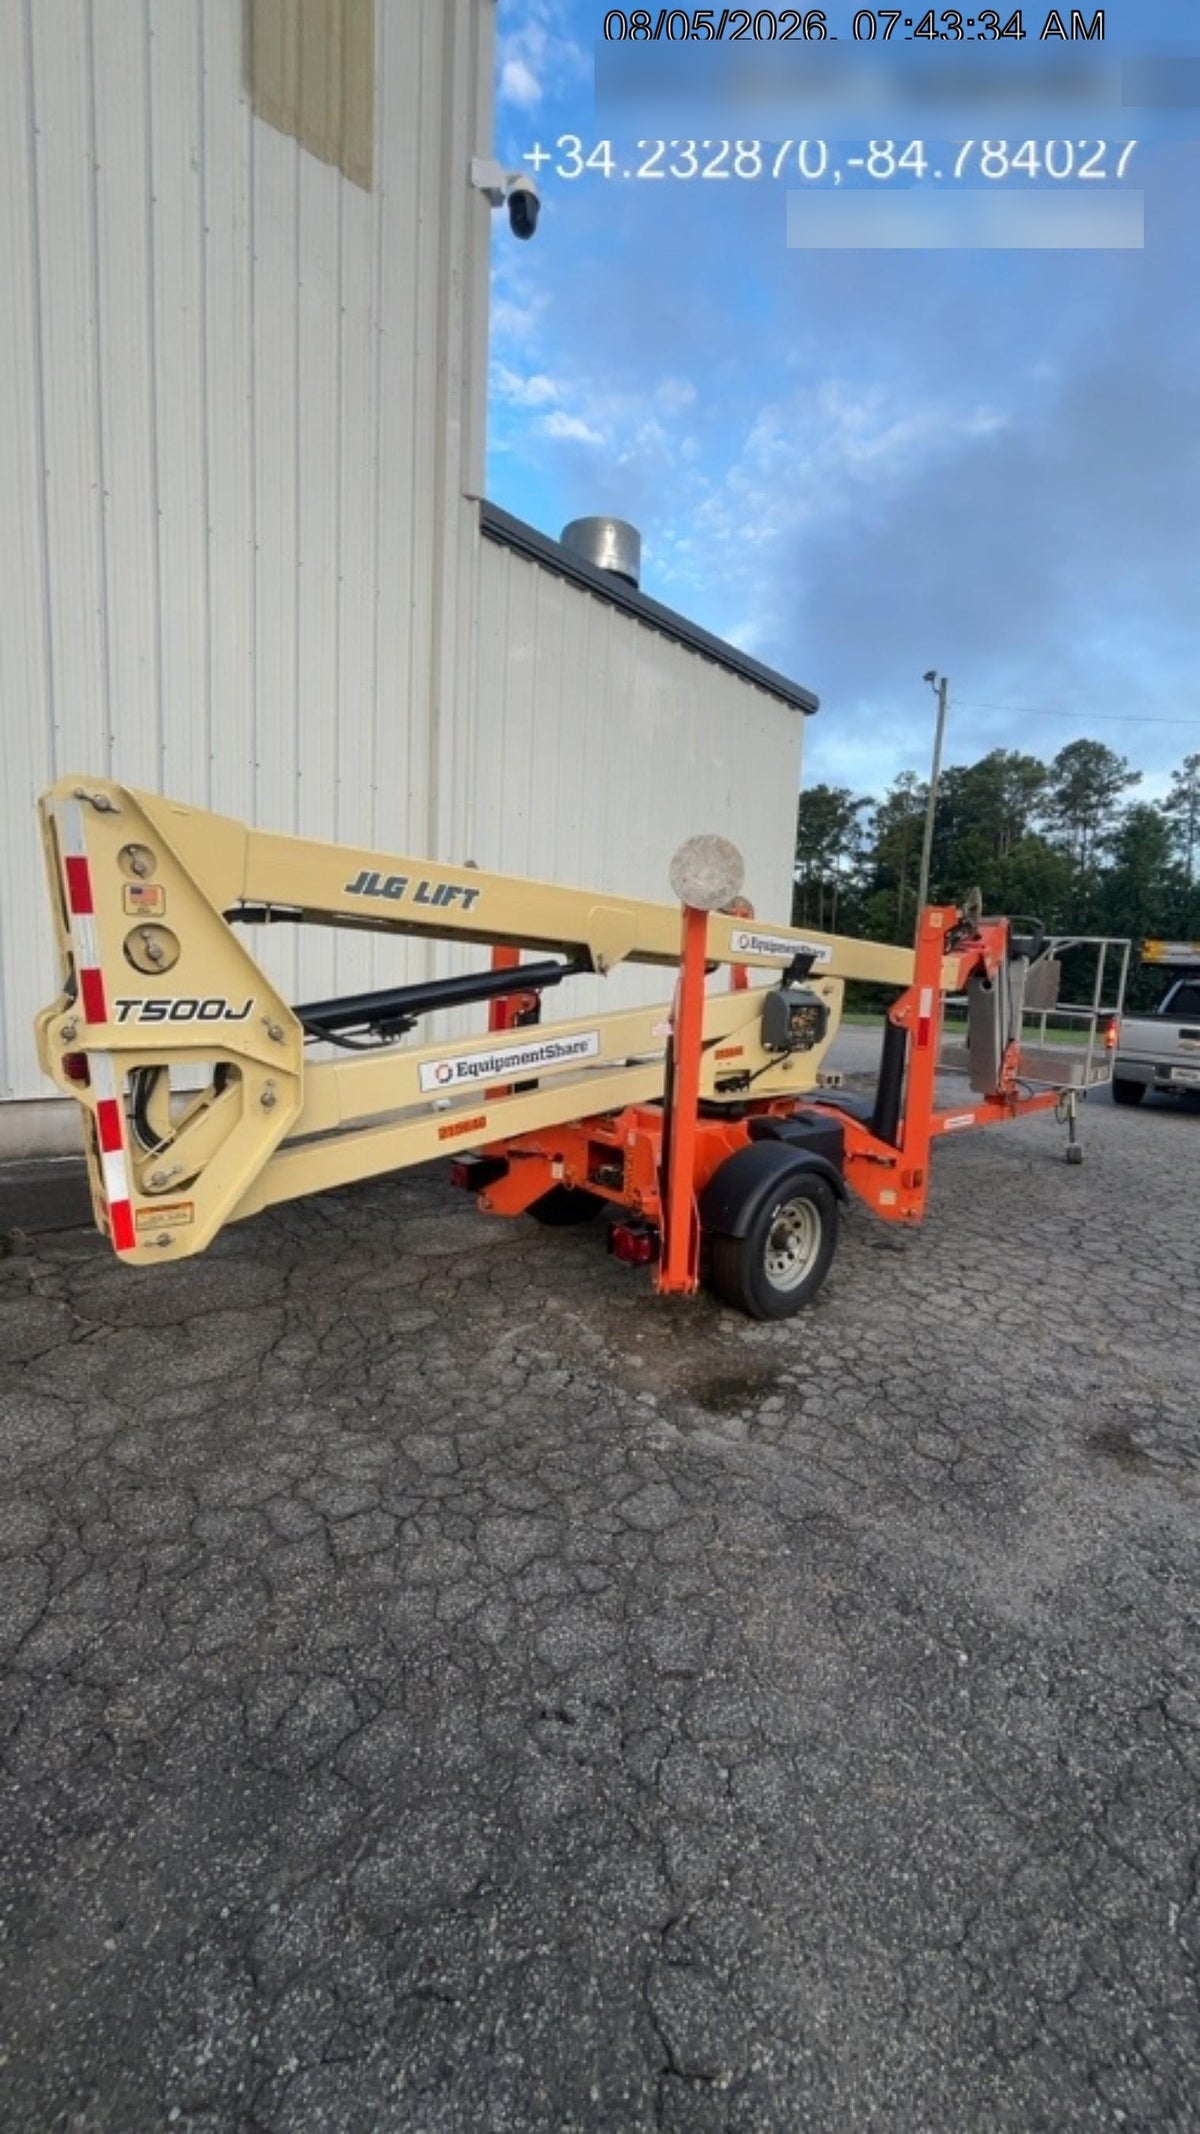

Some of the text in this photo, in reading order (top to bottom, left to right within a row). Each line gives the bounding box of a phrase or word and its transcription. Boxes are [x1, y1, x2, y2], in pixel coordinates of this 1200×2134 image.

[343, 871, 480, 910] JLG LIFT
[115, 999, 254, 1022] T500J
[457, 1040, 590, 1077] EquipmentShare
